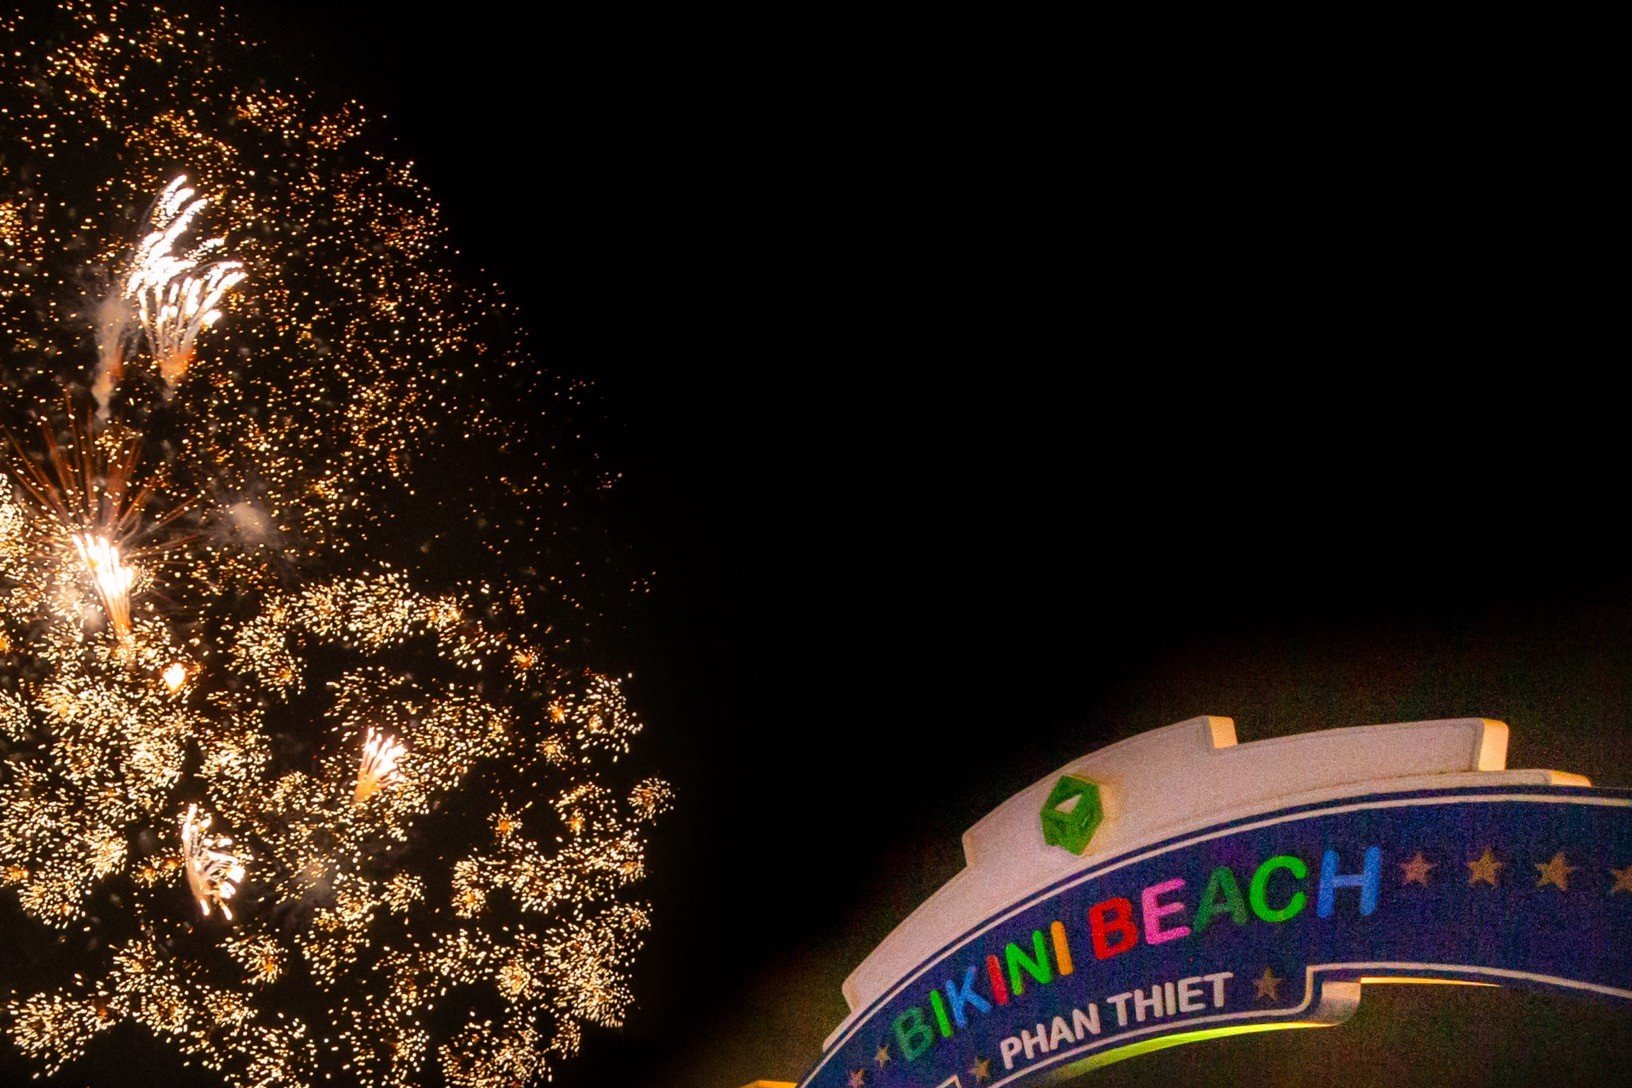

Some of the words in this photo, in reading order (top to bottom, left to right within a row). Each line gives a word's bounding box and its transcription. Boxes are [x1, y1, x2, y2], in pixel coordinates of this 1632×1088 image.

[892, 920, 1074, 1062] BIKINI
[1088, 846, 1382, 960] BEACH
[999, 1003, 1102, 1070] PHAN
[1107, 971, 1234, 1027] THIET
